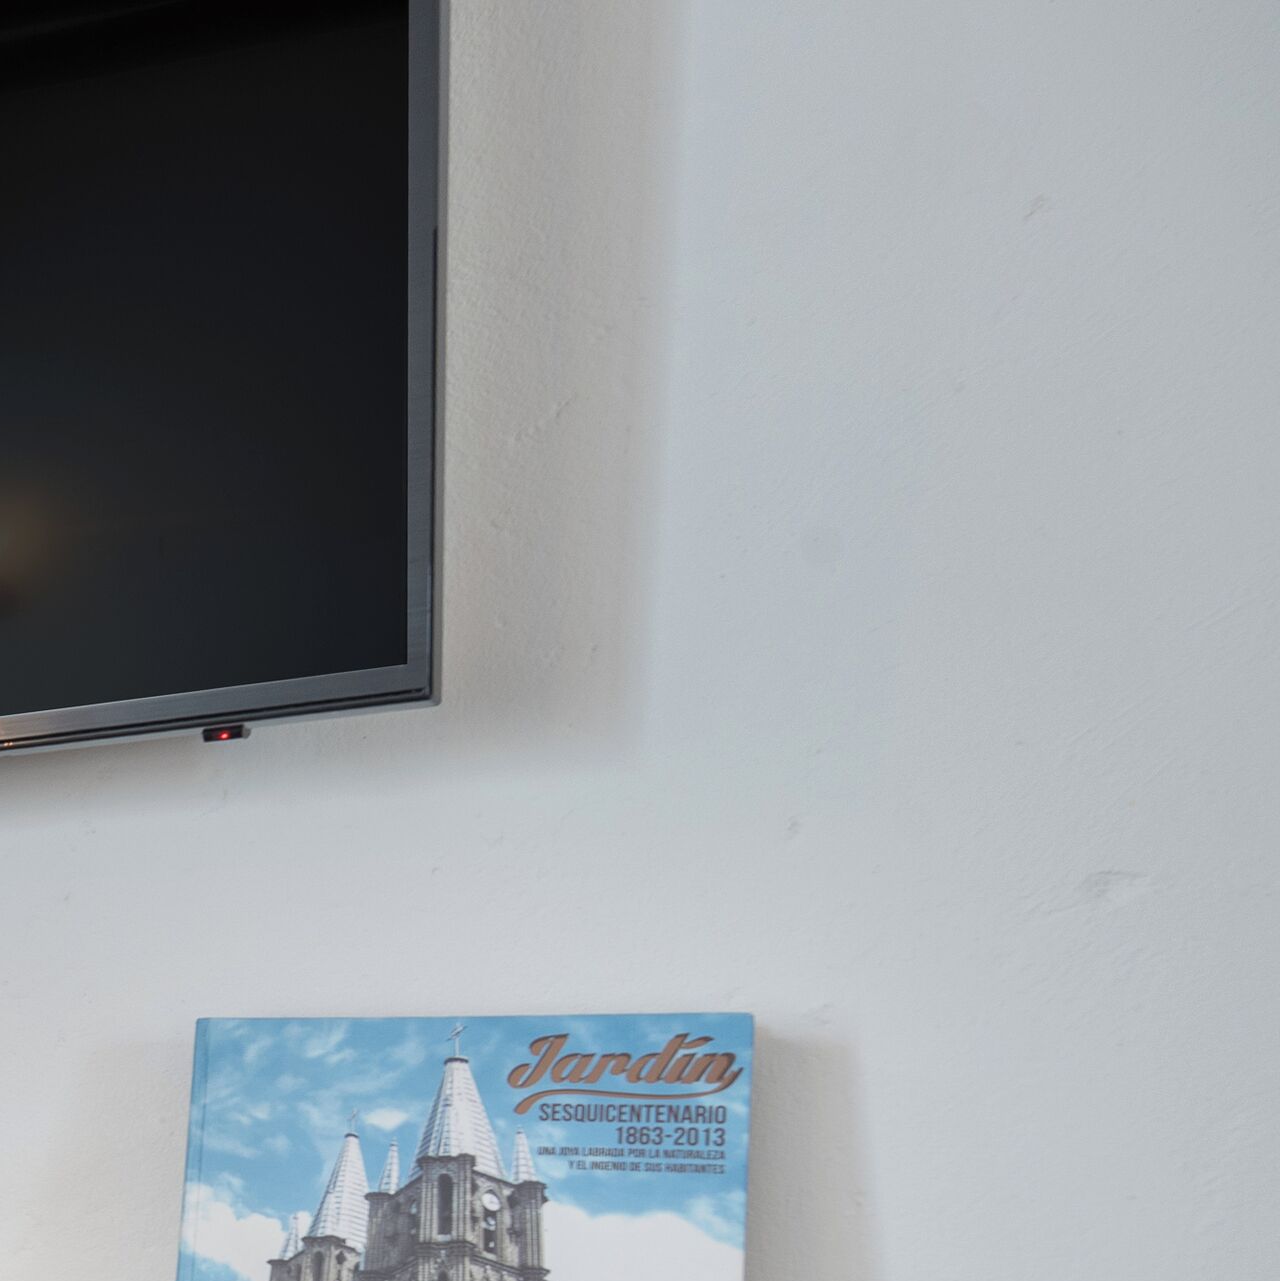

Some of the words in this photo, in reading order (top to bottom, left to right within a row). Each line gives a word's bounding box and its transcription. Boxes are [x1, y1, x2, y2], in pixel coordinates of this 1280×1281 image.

[507, 1033, 743, 1106] Jardín
[539, 1103, 727, 1124] SESQUICENTENARIO
[616, 1126, 726, 1146] 1863-2013
[628, 1148, 646, 1158] POR
[648, 1149, 661, 1158] LA
[663, 1149, 726, 1159] NATURALEZA
[576, 1161, 586, 1170] EL
[629, 1163, 641, 1172] DE
